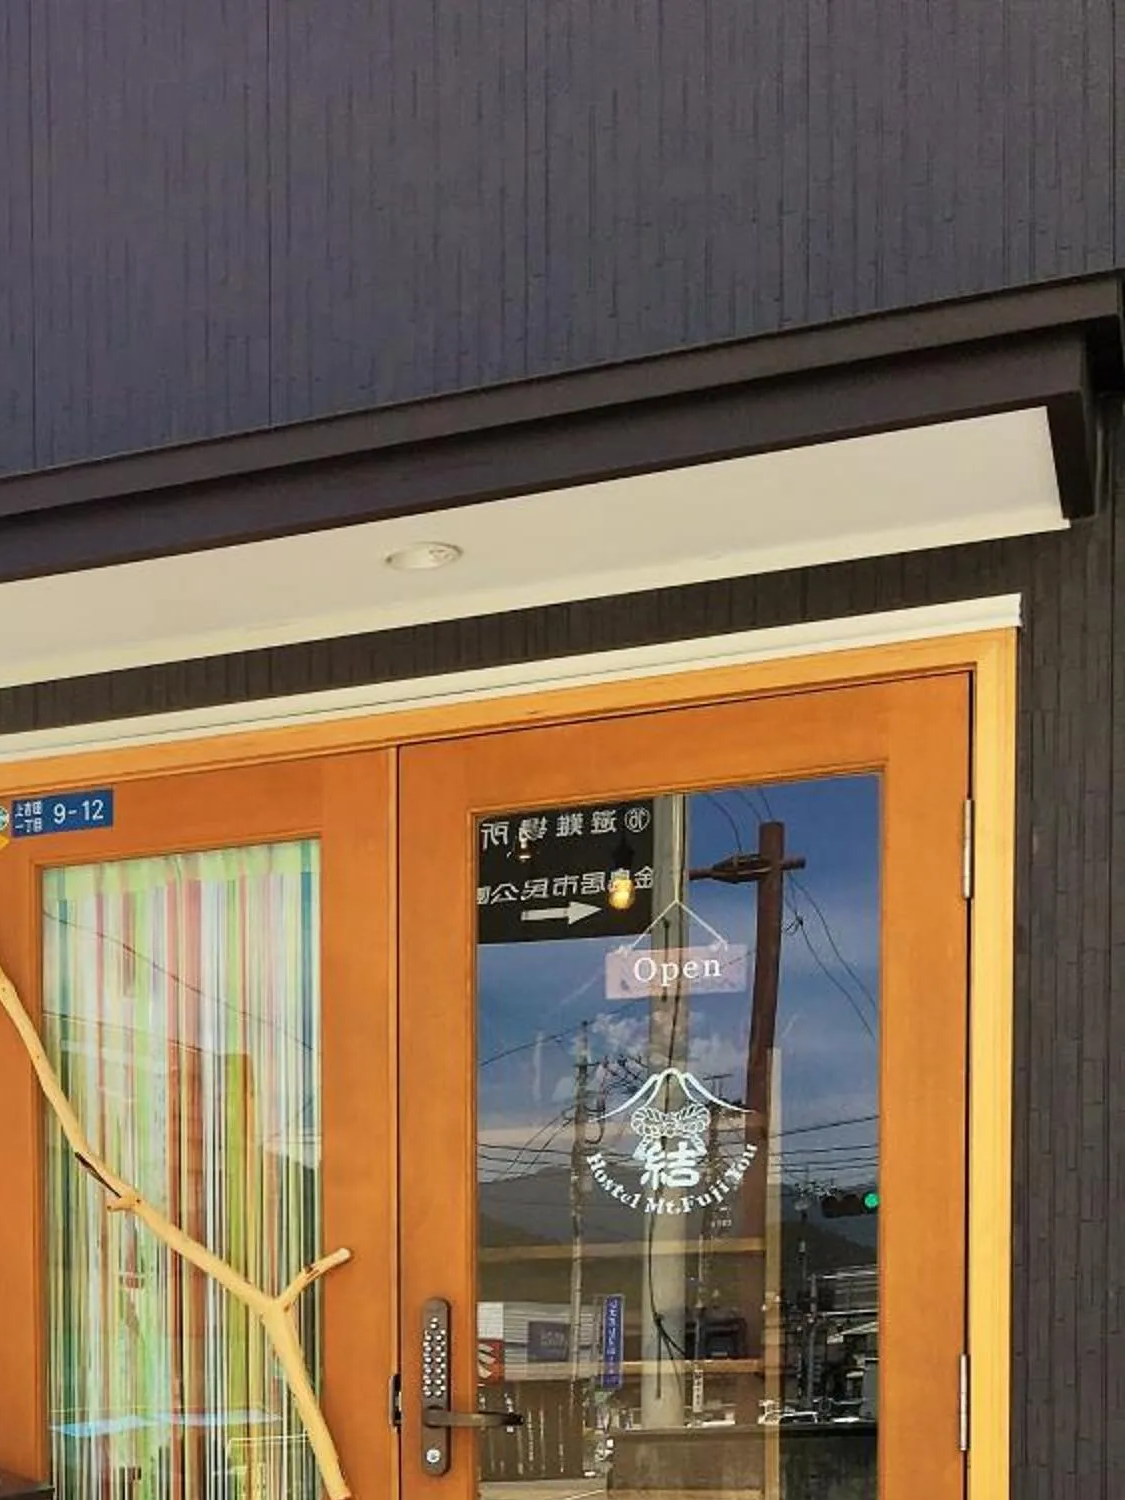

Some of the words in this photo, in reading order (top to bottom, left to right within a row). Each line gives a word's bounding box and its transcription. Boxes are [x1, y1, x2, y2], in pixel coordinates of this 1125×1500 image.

[53, 799, 104, 825] 9-12
[633, 956, 722, 987] Open
[586, 1153, 642, 1209] Hostel
